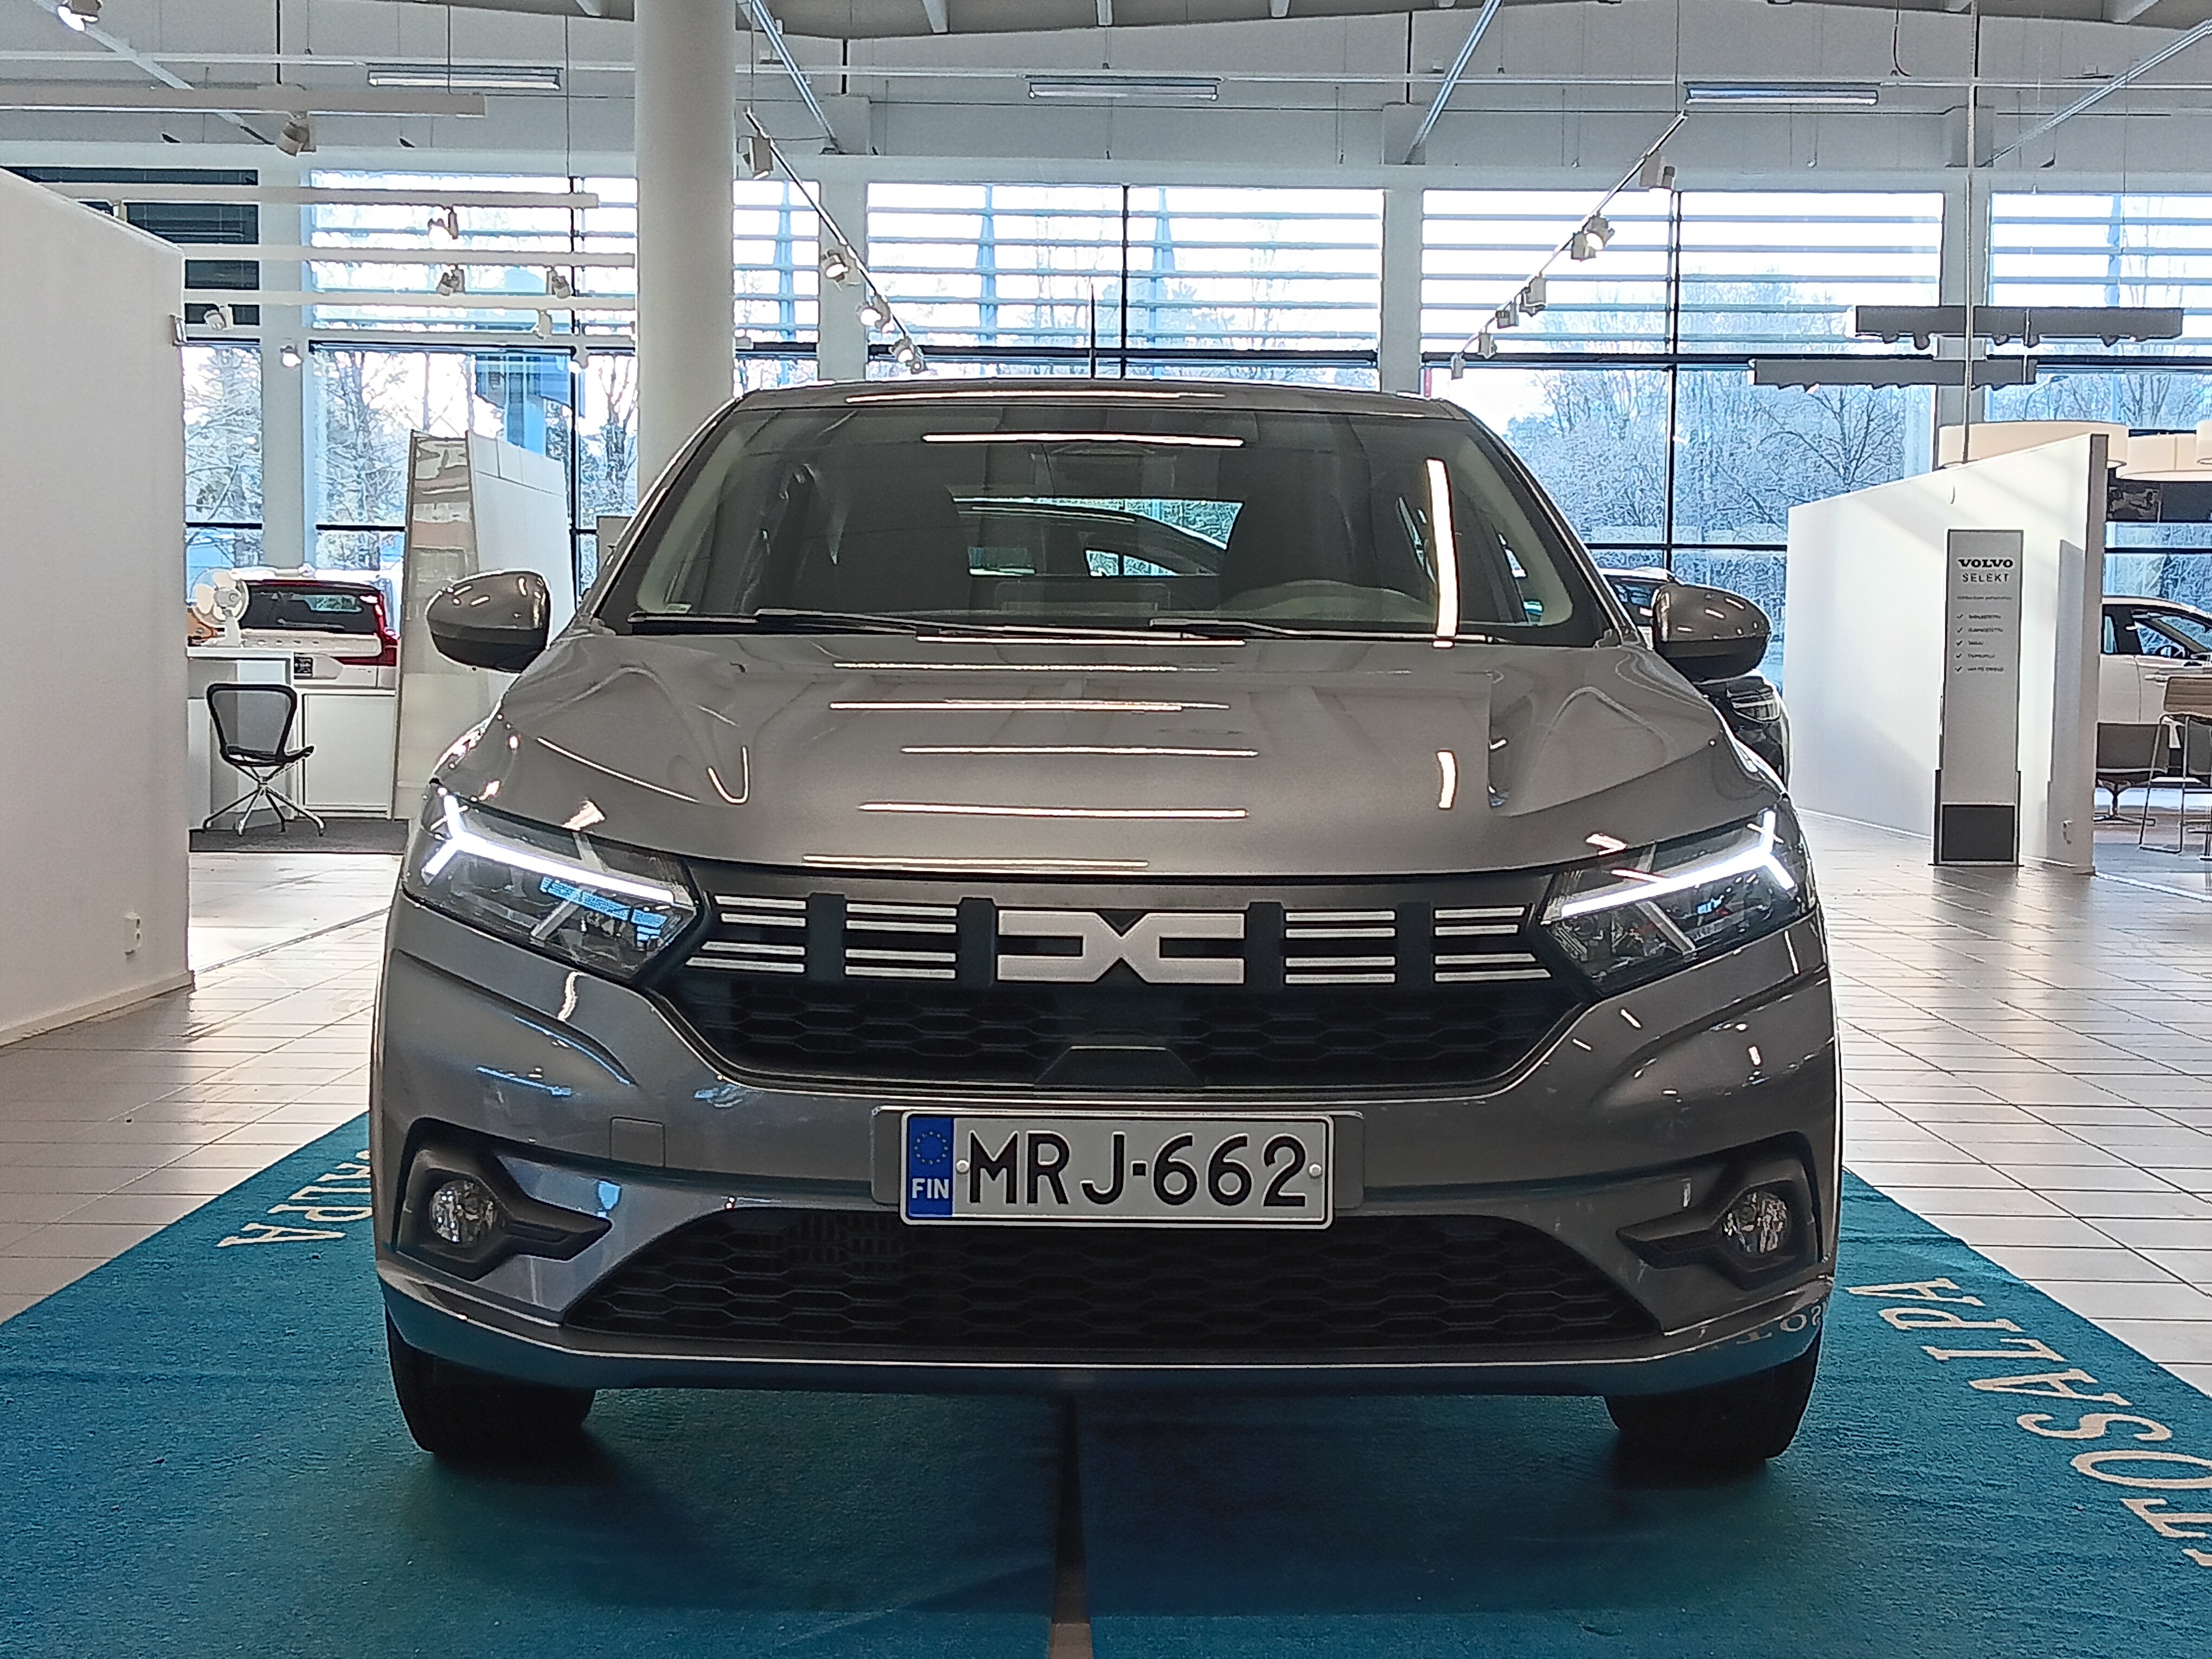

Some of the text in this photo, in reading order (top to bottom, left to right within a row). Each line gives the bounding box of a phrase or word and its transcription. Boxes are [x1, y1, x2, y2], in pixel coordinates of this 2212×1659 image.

[1958, 559, 2014, 568] VOLVO
[1962, 573, 2009, 582] SELEKT
[969, 1130, 1306, 1207] MRJ-662
[911, 1178, 950, 1200] FIN
